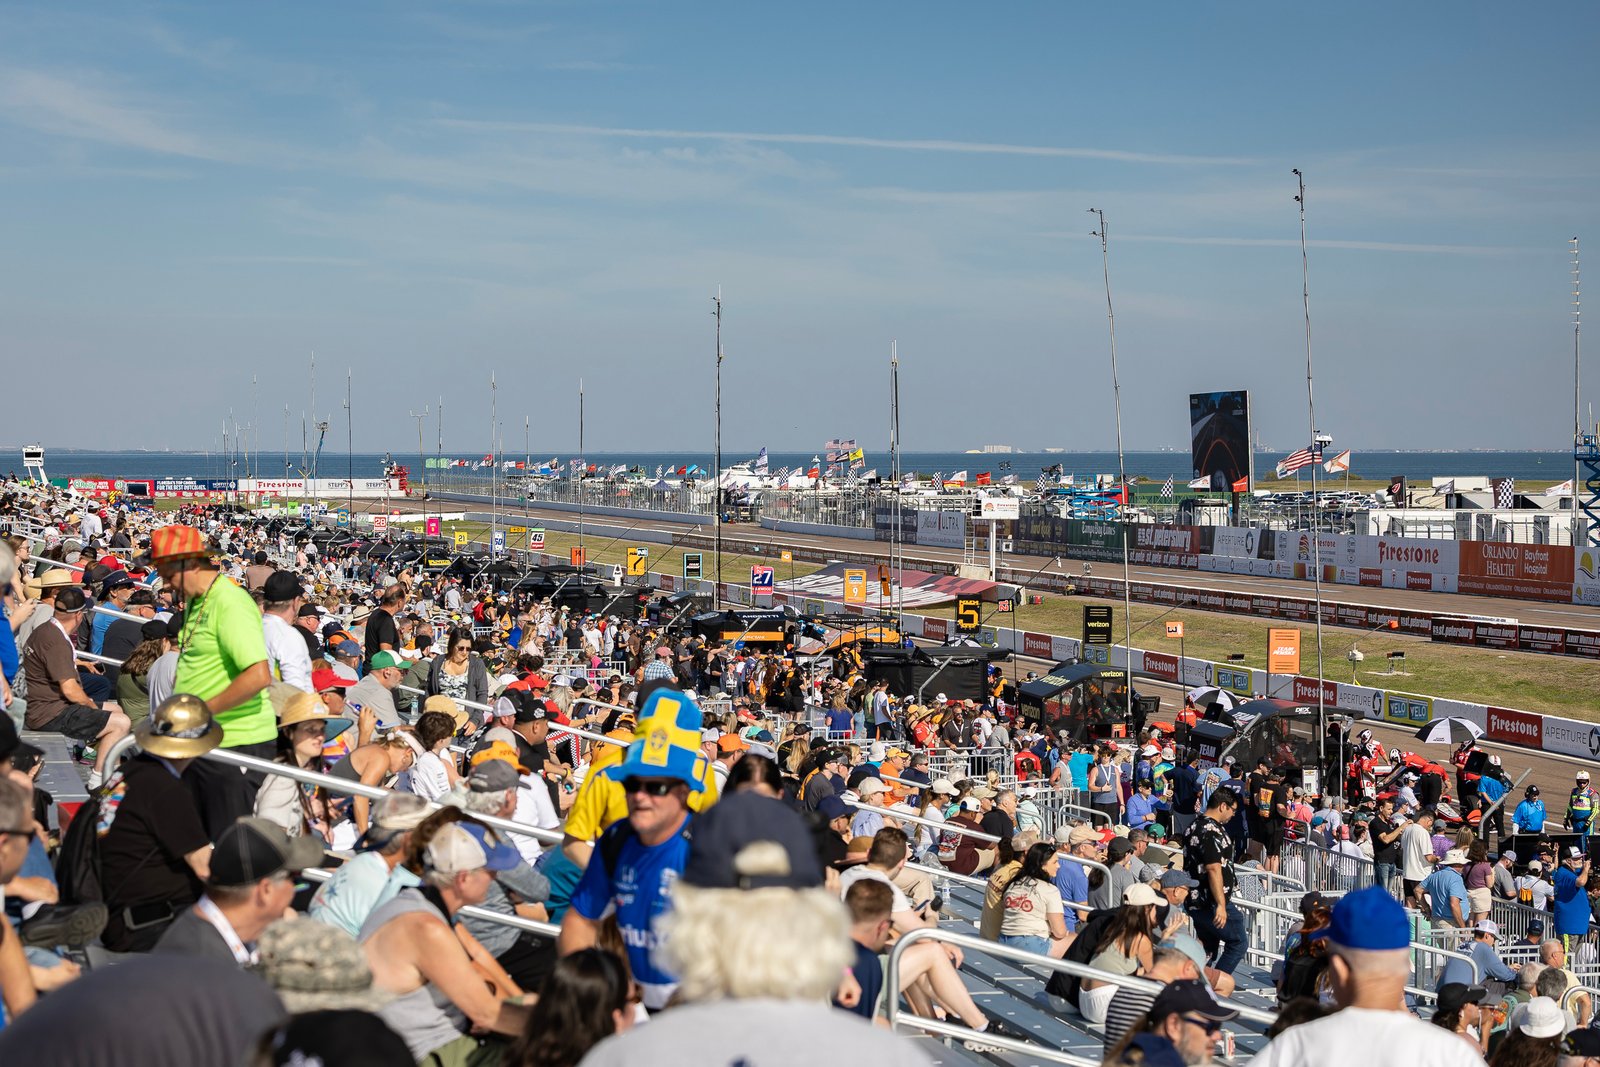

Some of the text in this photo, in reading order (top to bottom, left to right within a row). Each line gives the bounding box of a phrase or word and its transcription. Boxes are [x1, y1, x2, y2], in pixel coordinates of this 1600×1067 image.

[338, 512, 348, 523] 6
[375, 518, 386, 526] 28
[942, 516, 959, 529] ULTRA
[1103, 522, 1116, 536] Times
[532, 534, 543, 542] 45
[1217, 534, 1245, 546] APERTURE
[1378, 541, 1439, 564] Firestone
[1482, 544, 1518, 560] ORLANDO
[1525, 550, 1549, 562] Bayfront
[1486, 561, 1514, 576] HEALTH
[1525, 564, 1548, 576] Hospital
[753, 570, 771, 584] 27
[1360, 573, 1381, 581] Firestone
[1408, 576, 1430, 585] Firestone
[852, 587, 858, 596] 9
[958, 600, 979, 628] 5
[925, 622, 945, 633] Firestone
[1026, 636, 1050, 650] Firestone
[1145, 656, 1175, 673] Firestone
[1219, 674, 1248, 686] VELO VELO
[1339, 692, 1372, 706] APERTURE
[1021, 702, 1040, 720] verizon
[1390, 702, 1427, 717] VELO VELO
[1491, 714, 1538, 737] Firestone
[1545, 726, 1587, 744] APERTURE
[1200, 744, 1216, 757] TEAM
